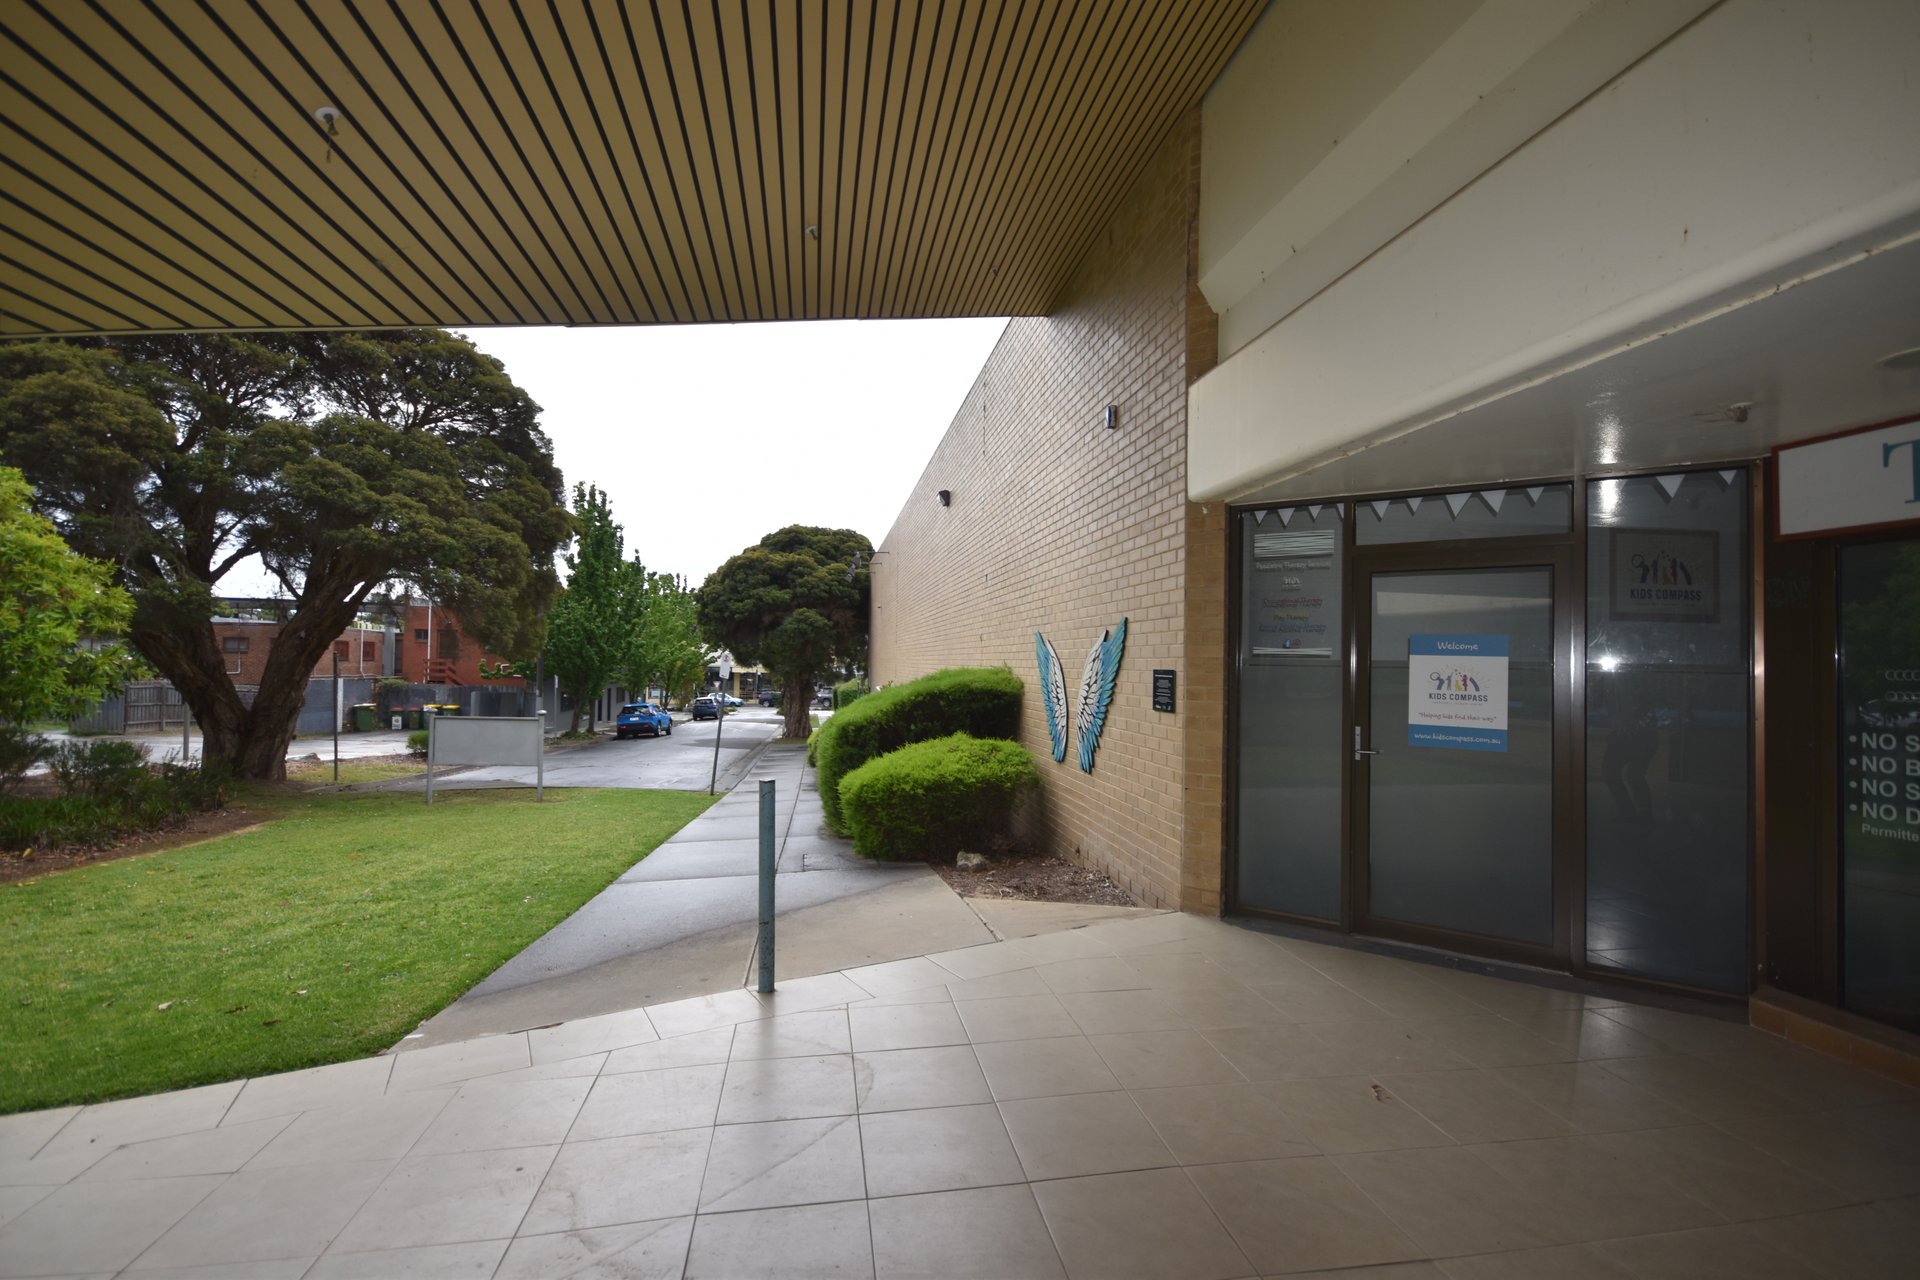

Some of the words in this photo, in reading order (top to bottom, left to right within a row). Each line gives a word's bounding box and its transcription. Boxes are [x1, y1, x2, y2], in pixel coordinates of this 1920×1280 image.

[1630, 588, 1653, 600] KIDS
[1656, 589, 1702, 601] COMPASS
[1437, 641, 1479, 651] Welcome
[1429, 693, 1447, 701] KIDS
[1449, 693, 1488, 702] COMPASS
[1414, 732, 1501, 744] www.kidscompass.com.au
[1862, 732, 1897, 751] NO
[1862, 755, 1897, 774] NO
[1862, 778, 1897, 797] NO
[1862, 801, 1897, 821] NO
